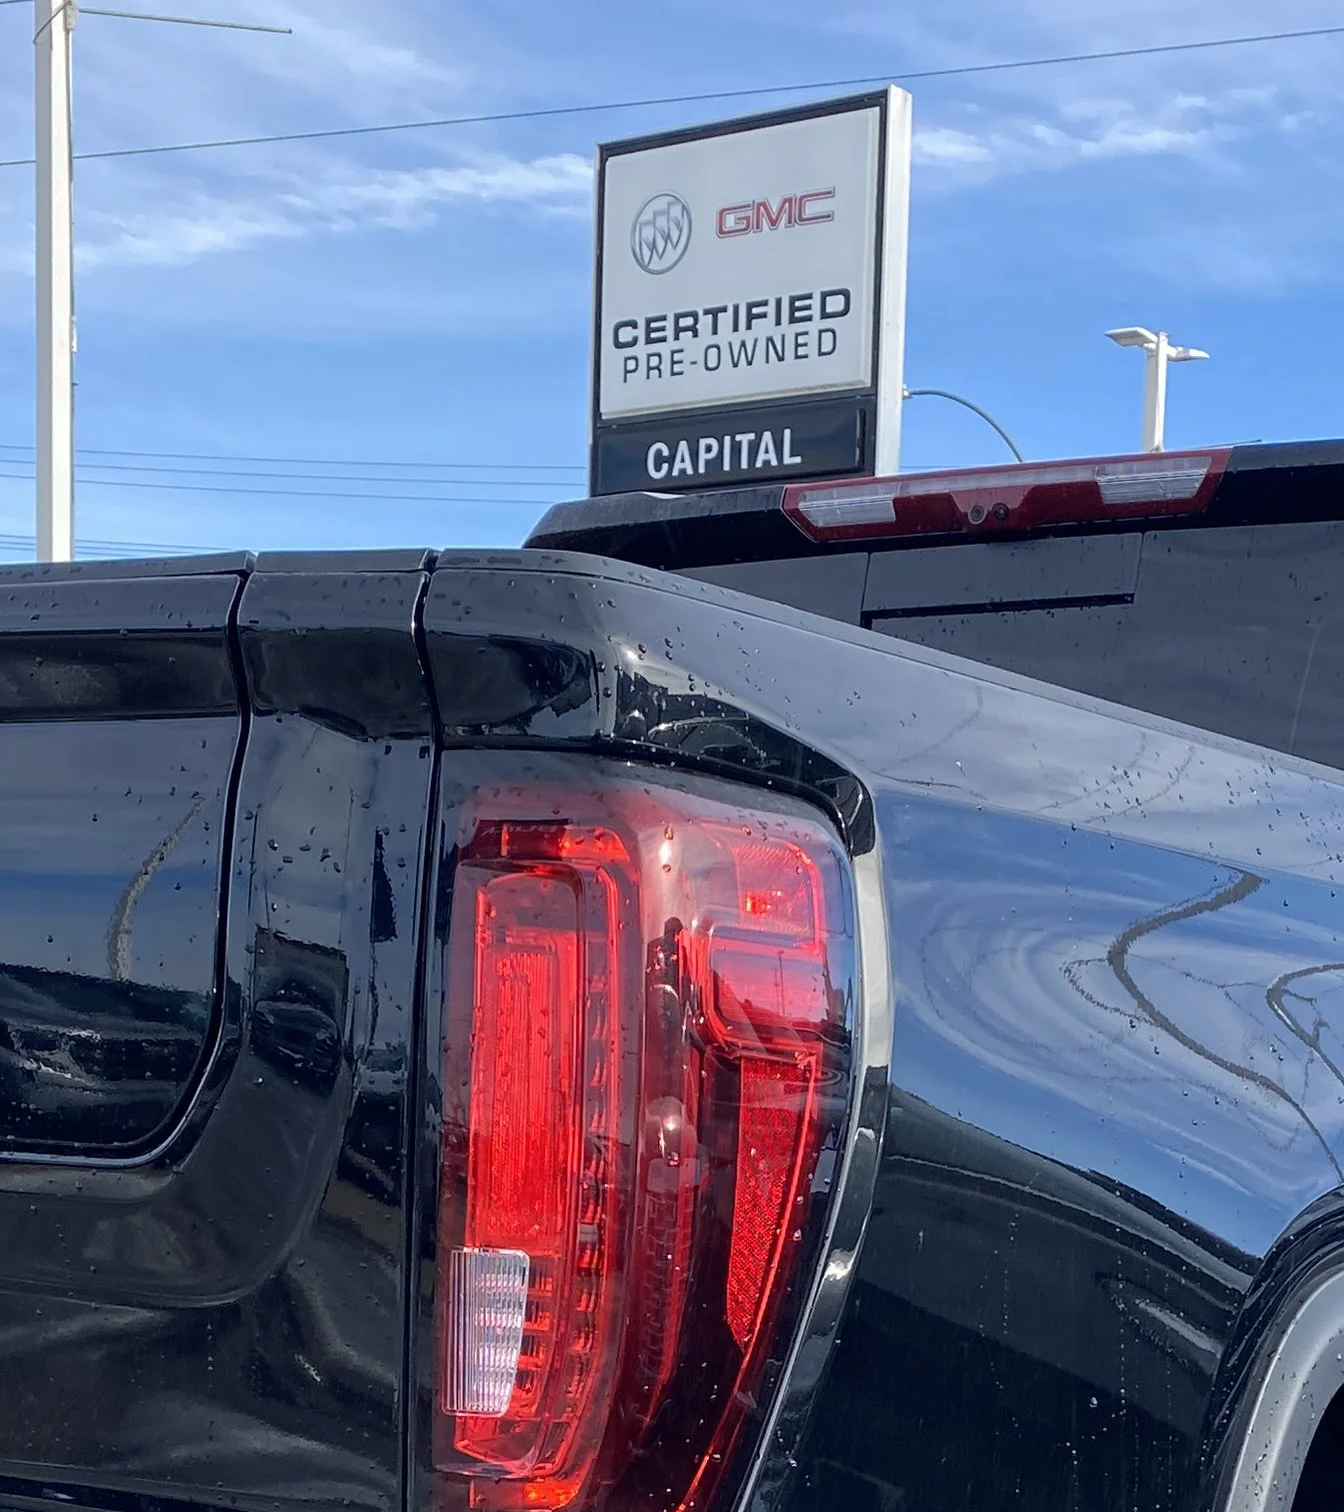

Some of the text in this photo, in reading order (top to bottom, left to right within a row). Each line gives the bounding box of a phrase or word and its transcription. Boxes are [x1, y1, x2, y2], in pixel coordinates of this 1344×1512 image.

[715, 186, 836, 239] GMC
[613, 288, 851, 349] CERTIFIED
[623, 328, 837, 383] PRE-OWNED
[646, 428, 803, 480] CAPITAL
